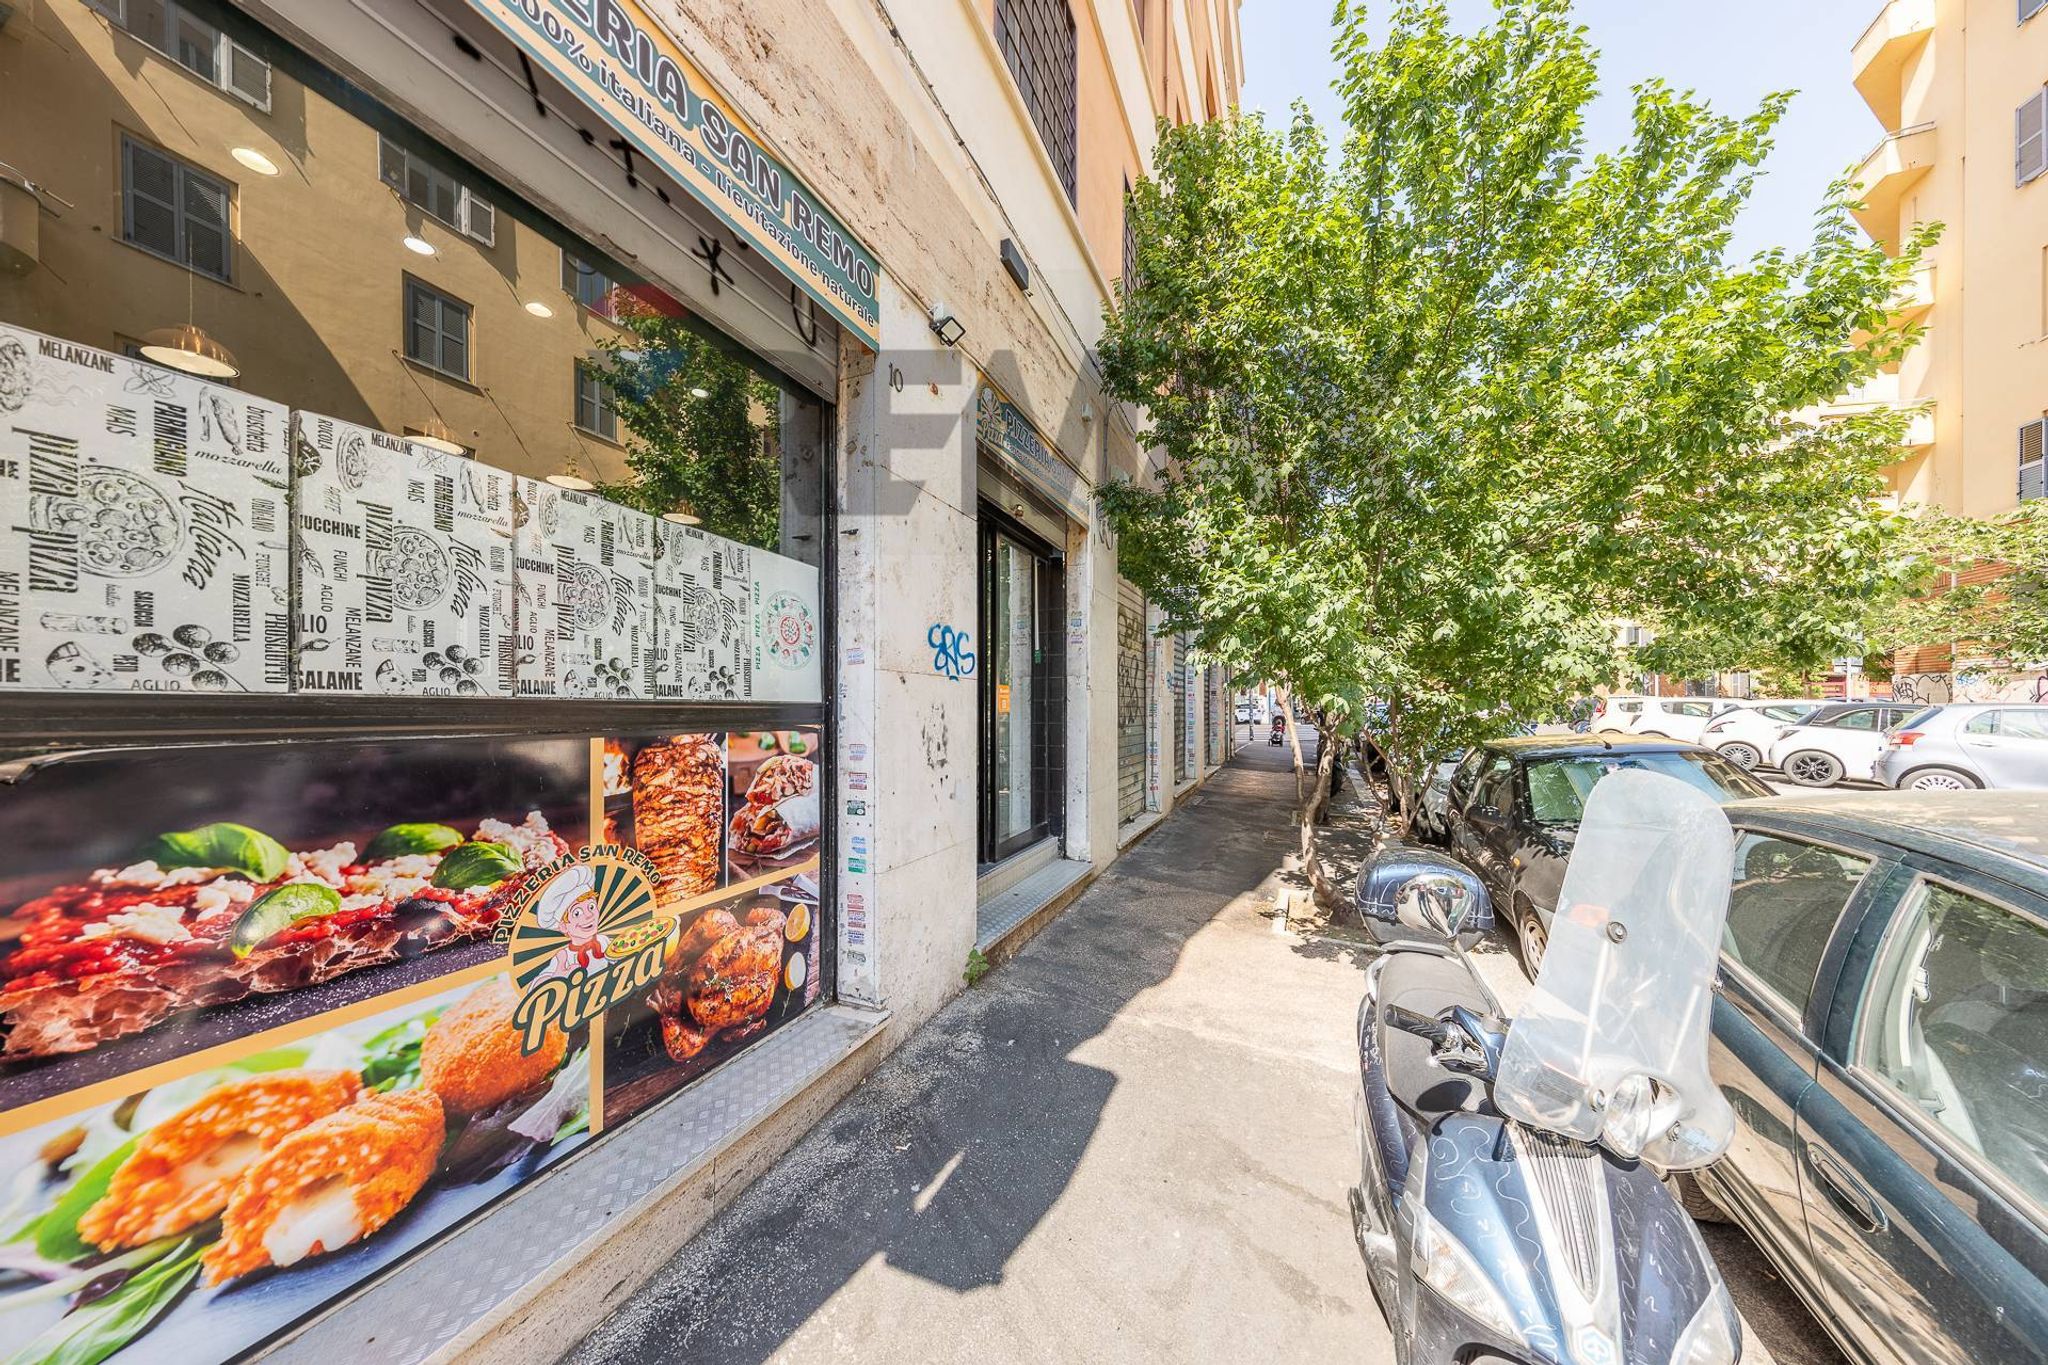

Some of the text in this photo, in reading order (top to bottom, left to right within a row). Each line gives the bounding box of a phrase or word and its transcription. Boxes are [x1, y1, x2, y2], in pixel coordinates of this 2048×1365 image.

[508, 0, 592, 72] 00%
[599, 57, 697, 168] italiana
[715, 169, 819, 276] Lievitazione
[821, 270, 875, 328] naturale
[700, 100, 782, 211] SAN
[791, 189, 874, 298] REMO
[39, 338, 115, 374] MELANZANE
[888, 361, 904, 393] 10
[106, 404, 136, 437] MAIS
[153, 400, 188, 477] PARMIGIANO
[317, 418, 333, 450] RUCOLA
[12, 426, 97, 498] pizza
[194, 450, 283, 475] mozzarella
[371, 432, 413, 456] MELANZANE
[407, 478, 425, 503] MAIS
[457, 511, 508, 527] mozzarella
[12, 526, 78, 593] pizza
[255, 552, 271, 588] FUNGHI
[333, 549, 348, 582] FUNGHI
[0, 571, 20, 653] MELANZANE
[134, 590, 154, 627] SALSICCIA
[232, 573, 251, 642] MOZZARELLA
[321, 583, 333, 613] AGLIO
[264, 612, 288, 684] PROSCIUTTO
[345, 606, 362, 668] MELANZANE
[479, 604, 491, 659] MOZZARELLA
[544, 629, 556, 678] MELANZANE
[130, 678, 182, 691] AGLIO
[422, 686, 451, 697] AGLIO
[492, 844, 663, 945] PIZZERIA SAN REMO
[513, 938, 667, 1057] Pizza
